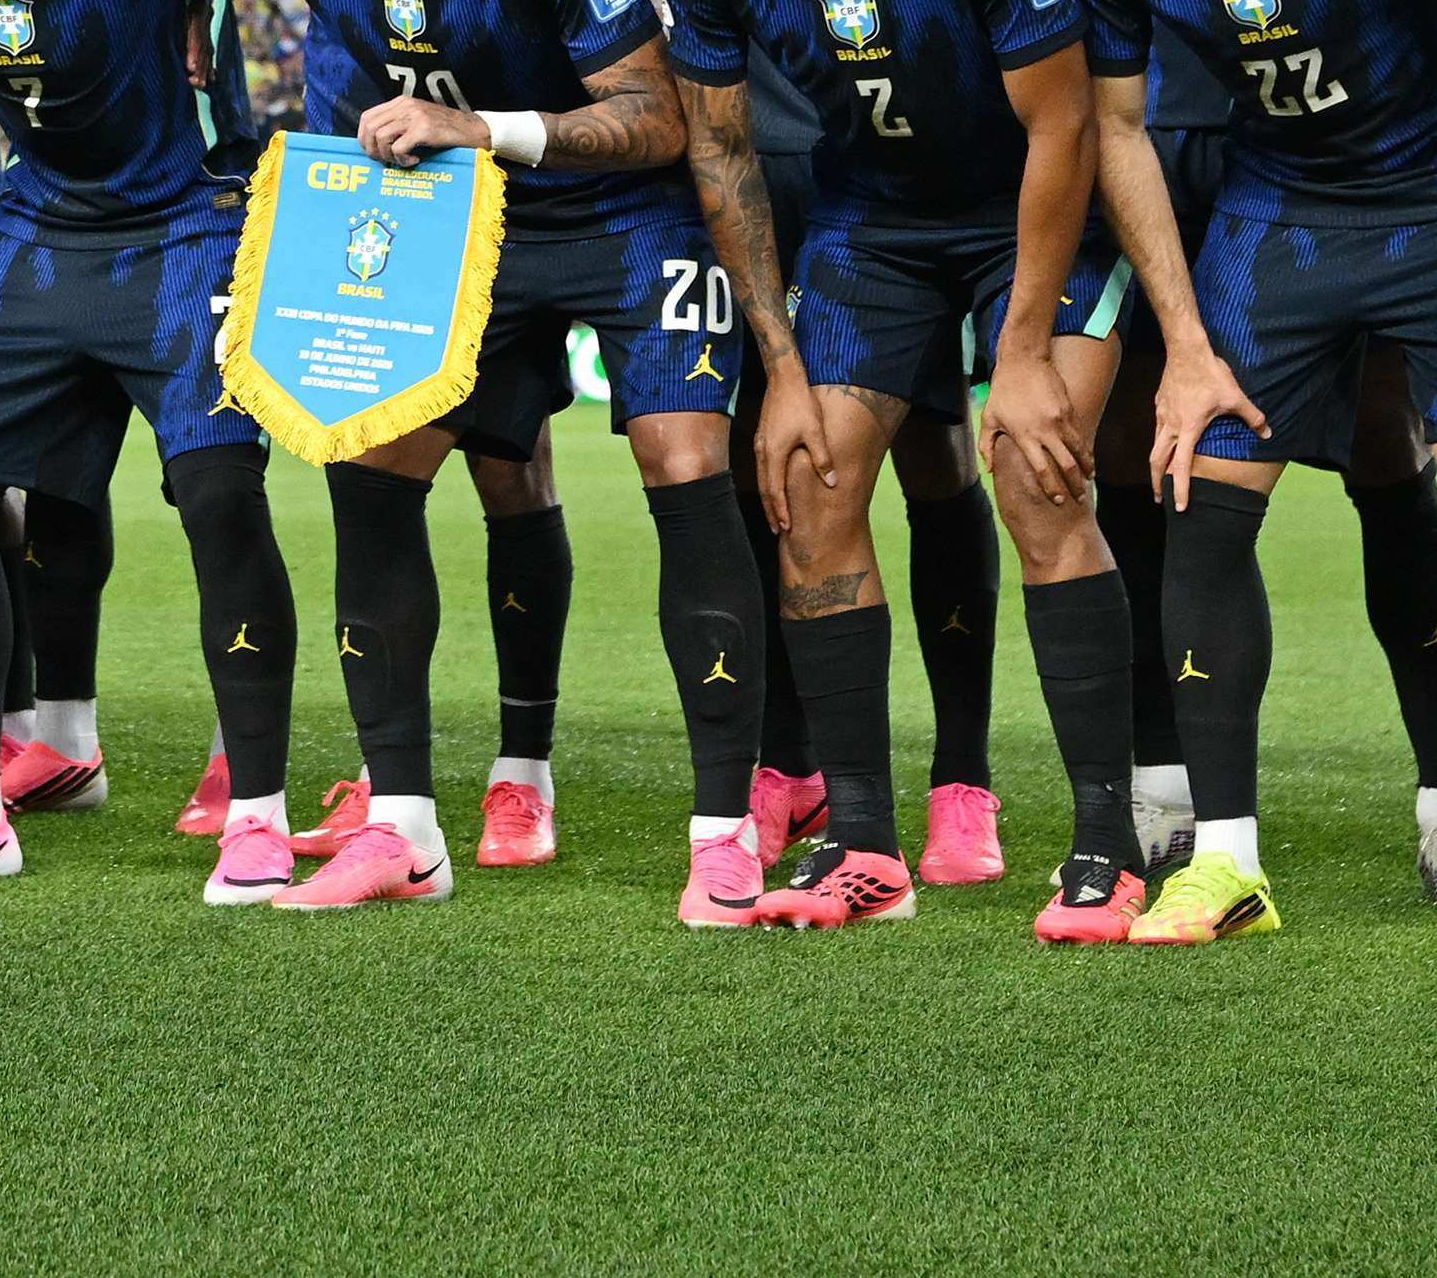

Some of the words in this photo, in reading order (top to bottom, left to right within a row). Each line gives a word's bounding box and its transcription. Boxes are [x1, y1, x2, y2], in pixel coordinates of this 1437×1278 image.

[0, 15, 17, 23] CBF
[840, 6, 860, 16] CBF
[1237, 23, 1299, 45] BRASIL
[389, 38, 438, 54] BRASIL
[836, 46, 892, 61] BRASIL
[1240, 47, 1349, 118] 22
[9, 77, 42, 128] 7
[855, 78, 914, 138] 2
[307, 161, 370, 192] CBF
[394, 188, 435, 200] FUTEBOL
[337, 282, 385, 299] BRASIL
[662, 259, 732, 335] 20
[298, 309, 323, 322] COPA
[339, 314, 375, 328] MUNDO
[389, 320, 411, 332] FIFA
[310, 350, 324, 361] DE
[312, 337, 345, 351] BRASIL
[359, 343, 386, 356] HAITI
[308, 363, 377, 381] PHILADELPHIA
[299, 375, 343, 390] ESTADOS
